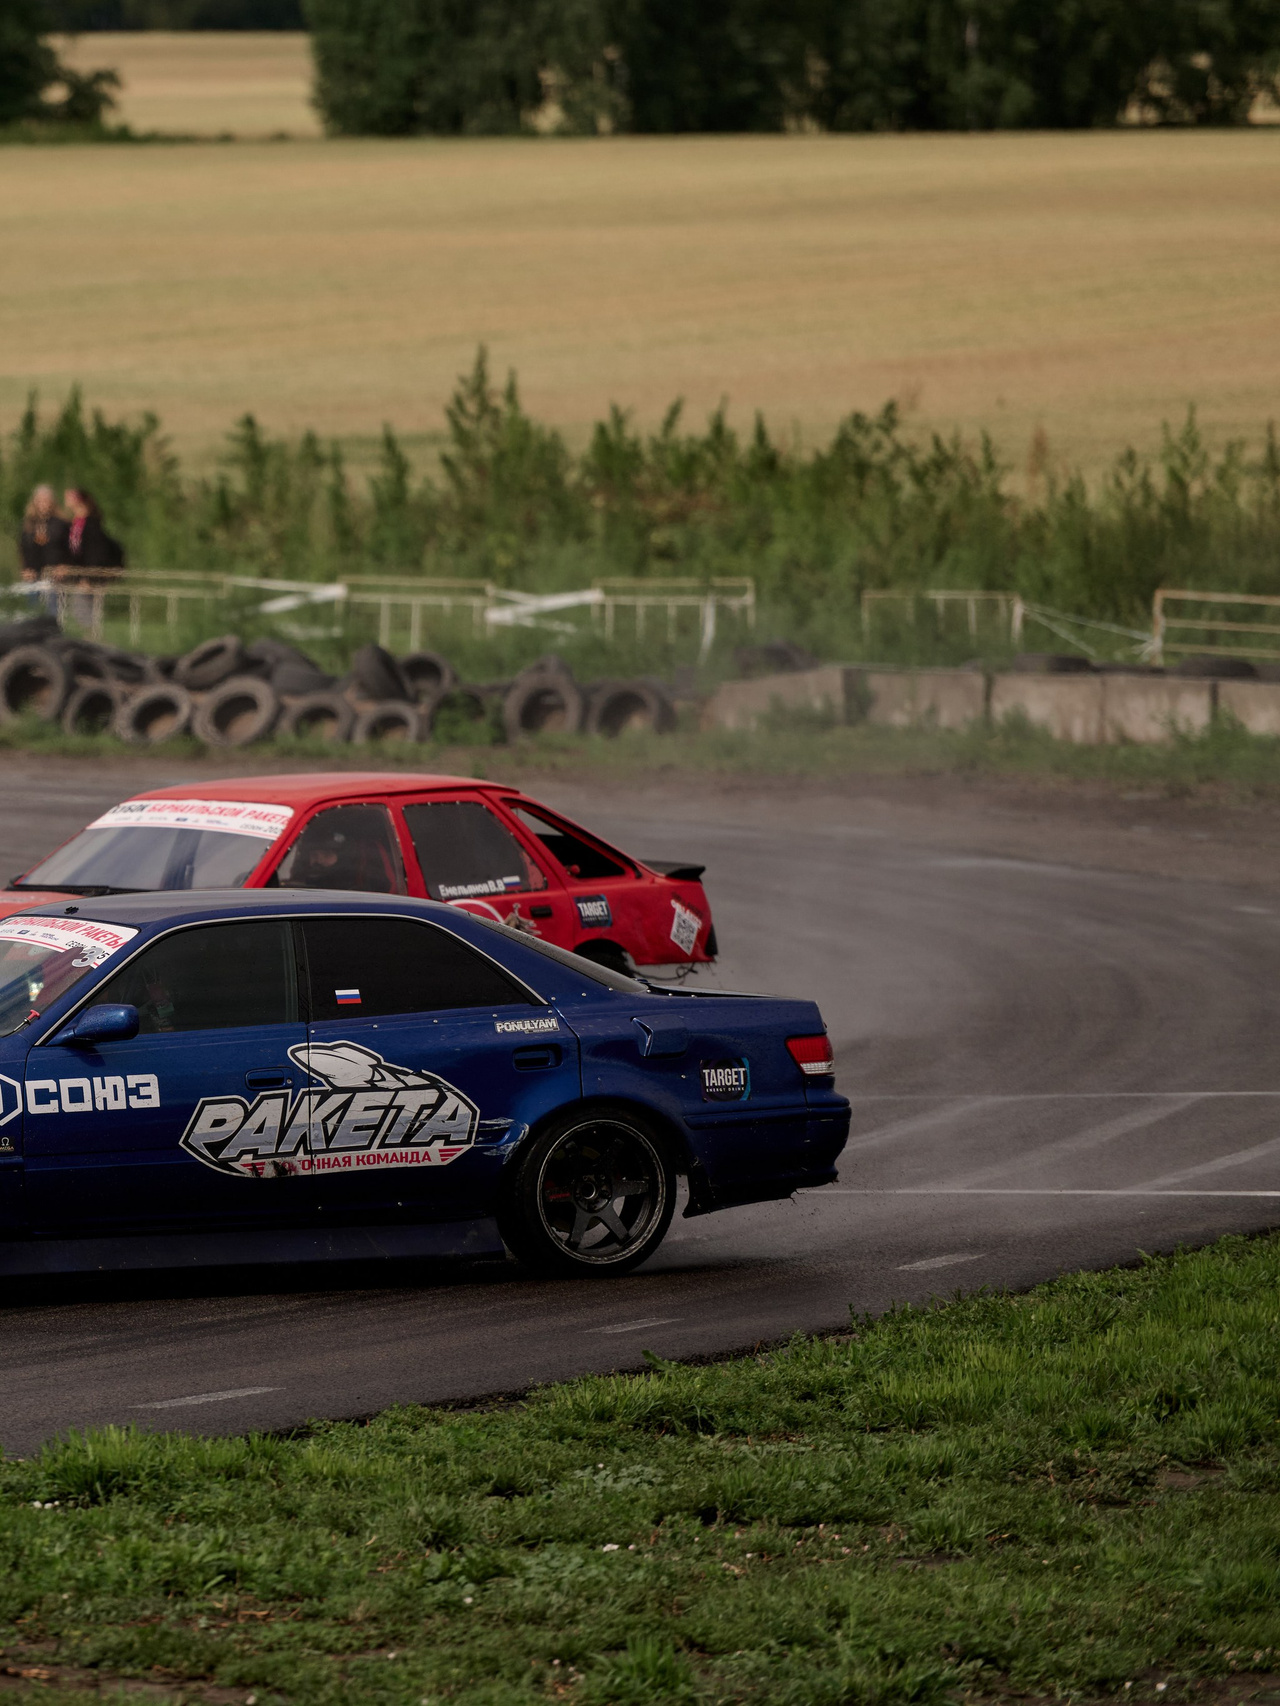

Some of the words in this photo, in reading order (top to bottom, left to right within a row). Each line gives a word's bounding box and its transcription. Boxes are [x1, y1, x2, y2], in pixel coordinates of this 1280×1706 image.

[438, 883, 489, 897] Емельянов
[577, 900, 609, 917] TARGET
[72, 947, 103, 968] 3
[496, 1017, 557, 1033] PONULYAM
[702, 1067, 746, 1087] TARGET
[24, 1073, 161, 1115] СОЮЗ
[183, 1088, 478, 1161] РАКЕТА
[355, 1150, 433, 1167] КОМАНДА
